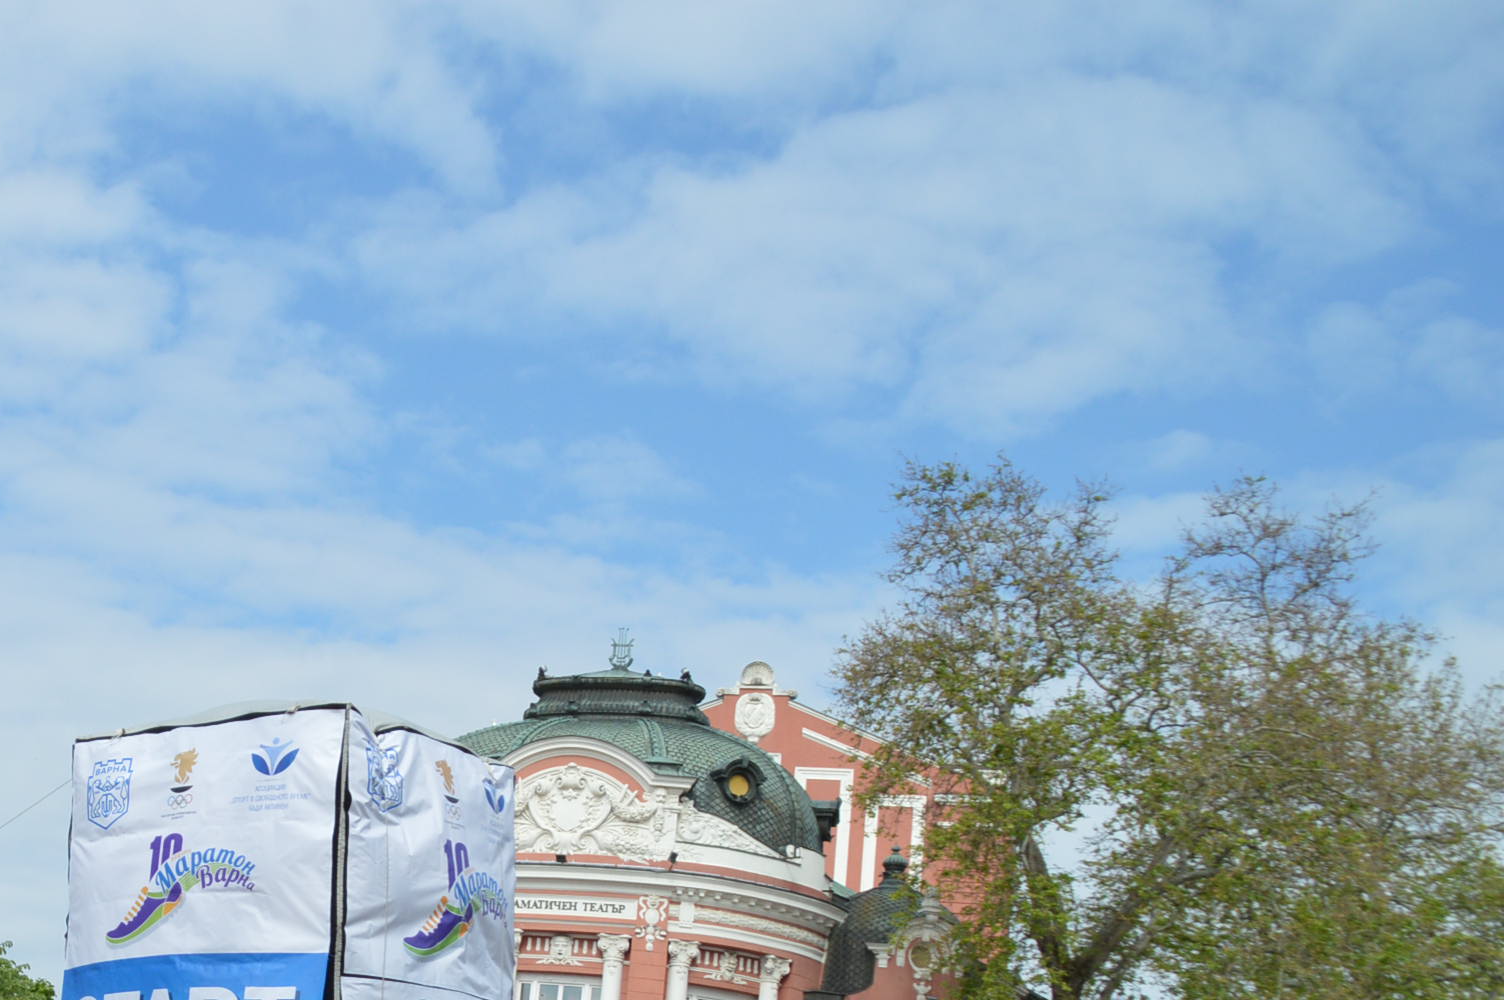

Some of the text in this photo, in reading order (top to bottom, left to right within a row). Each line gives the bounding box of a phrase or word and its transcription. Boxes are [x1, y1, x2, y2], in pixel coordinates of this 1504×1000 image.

[96, 765, 127, 775] ВАРНА
[156, 847, 256, 894] Маратон
[196, 865, 255, 891] Варна
[583, 902, 626, 914] ТЕАТЪР
